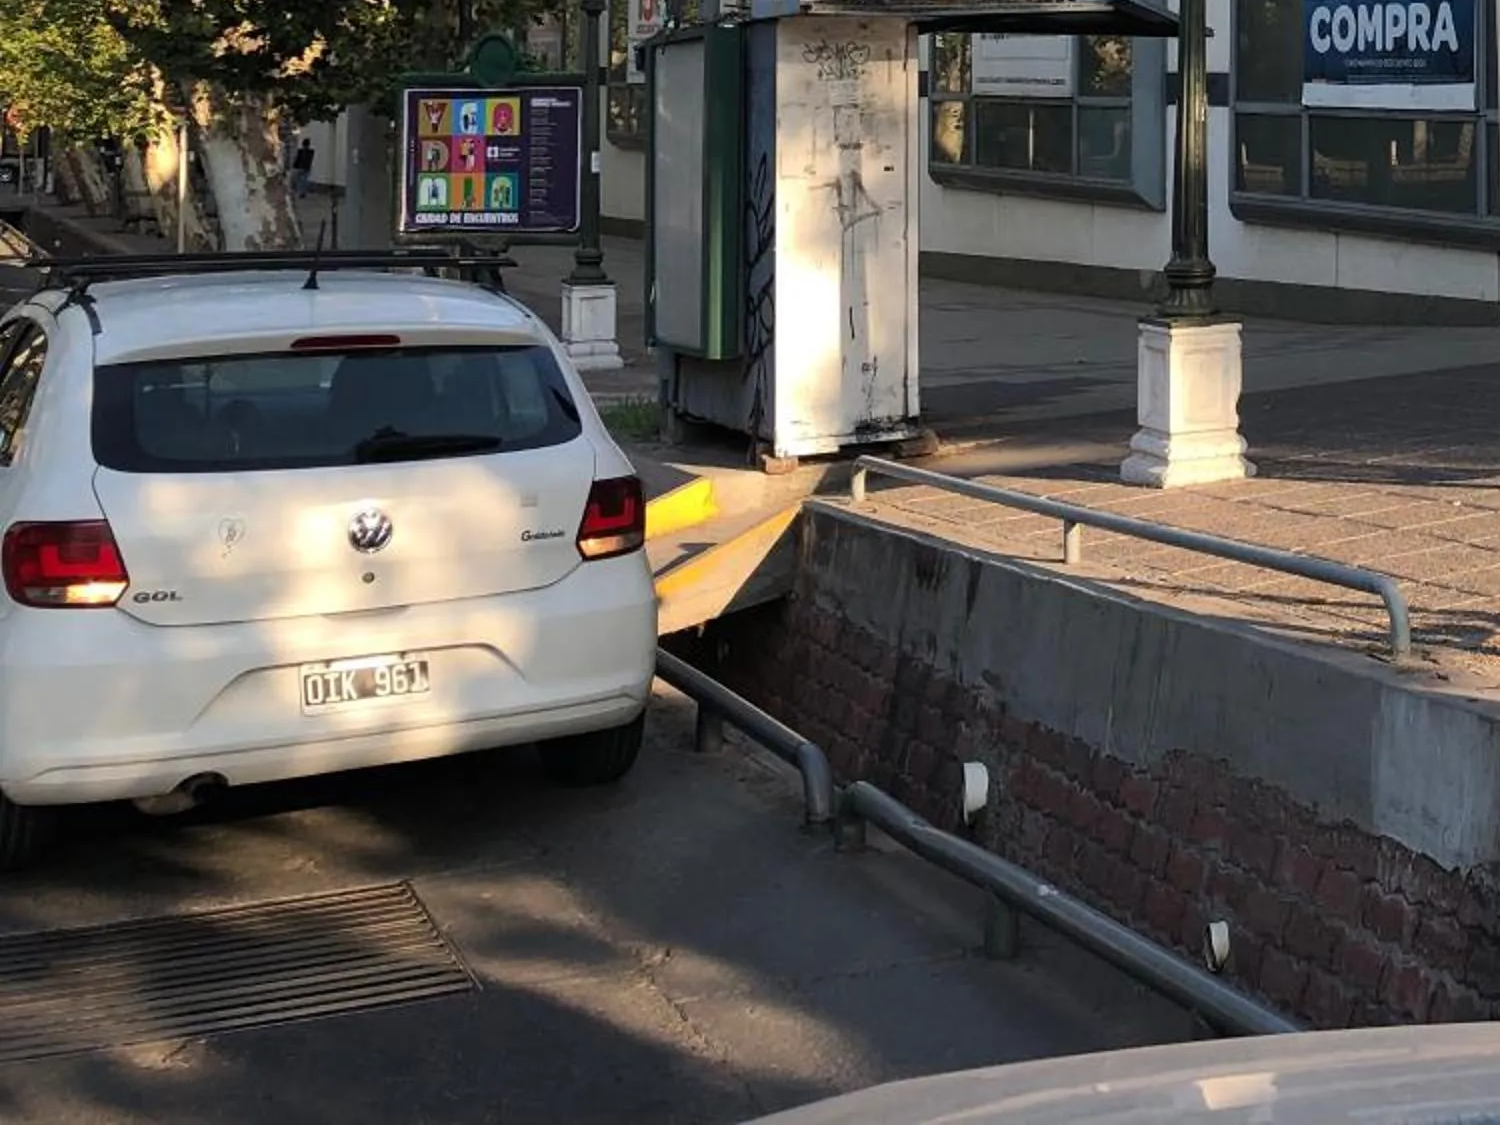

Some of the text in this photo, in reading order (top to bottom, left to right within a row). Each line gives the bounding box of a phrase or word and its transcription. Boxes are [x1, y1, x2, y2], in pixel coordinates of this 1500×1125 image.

[1309, 1, 1459, 53] COMPRA
[132, 590, 183, 604] GOL
[306, 663, 427, 704] OIK 961
